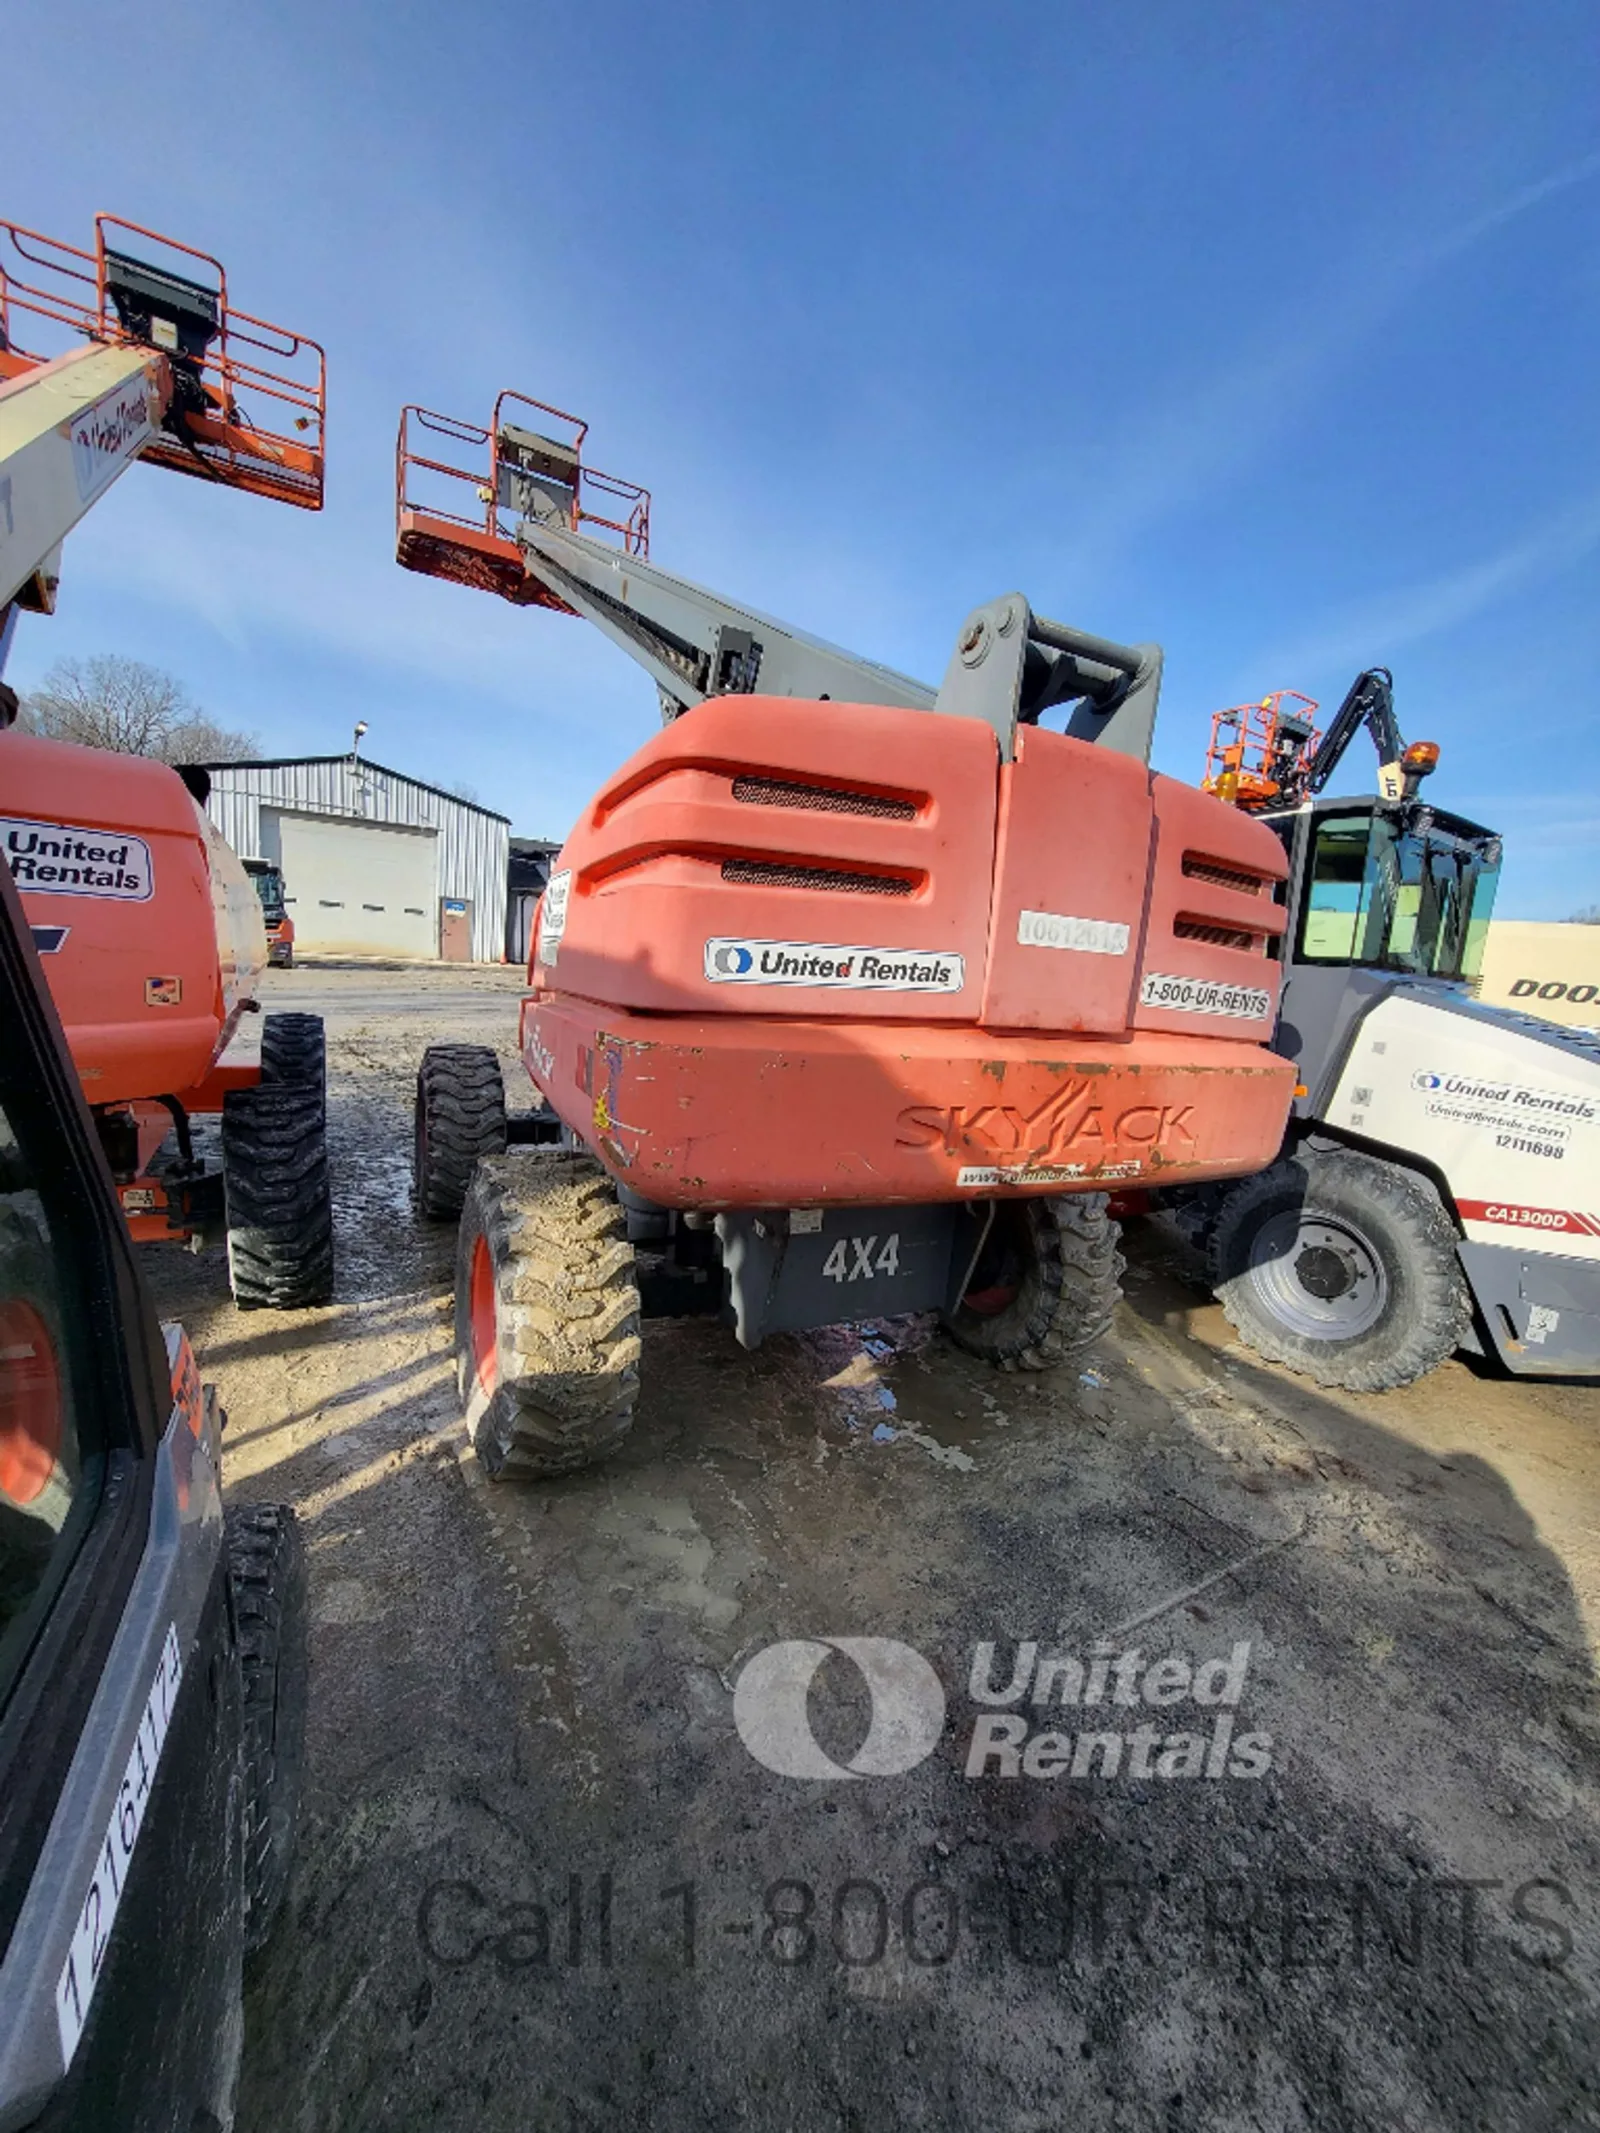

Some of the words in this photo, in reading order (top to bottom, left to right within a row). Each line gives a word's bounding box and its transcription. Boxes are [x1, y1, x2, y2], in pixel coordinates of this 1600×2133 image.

[8, 831, 129, 866] United
[10, 856, 141, 890] Rentals
[760, 950, 855, 979] United
[859, 955, 952, 984] Rentals
[1146, 981, 1268, 1014] 1-800-UR-RENTS
[1508, 978, 1600, 1005] DOO
[1444, 1078, 1509, 1102] United
[1513, 1091, 1596, 1118] Rentals
[894, 1079, 1197, 1160] SKYJACK
[1495, 1134, 1565, 1160] 12111698
[1485, 1205, 1568, 1228] CA1300D
[822, 1232, 900, 1283] 4X4
